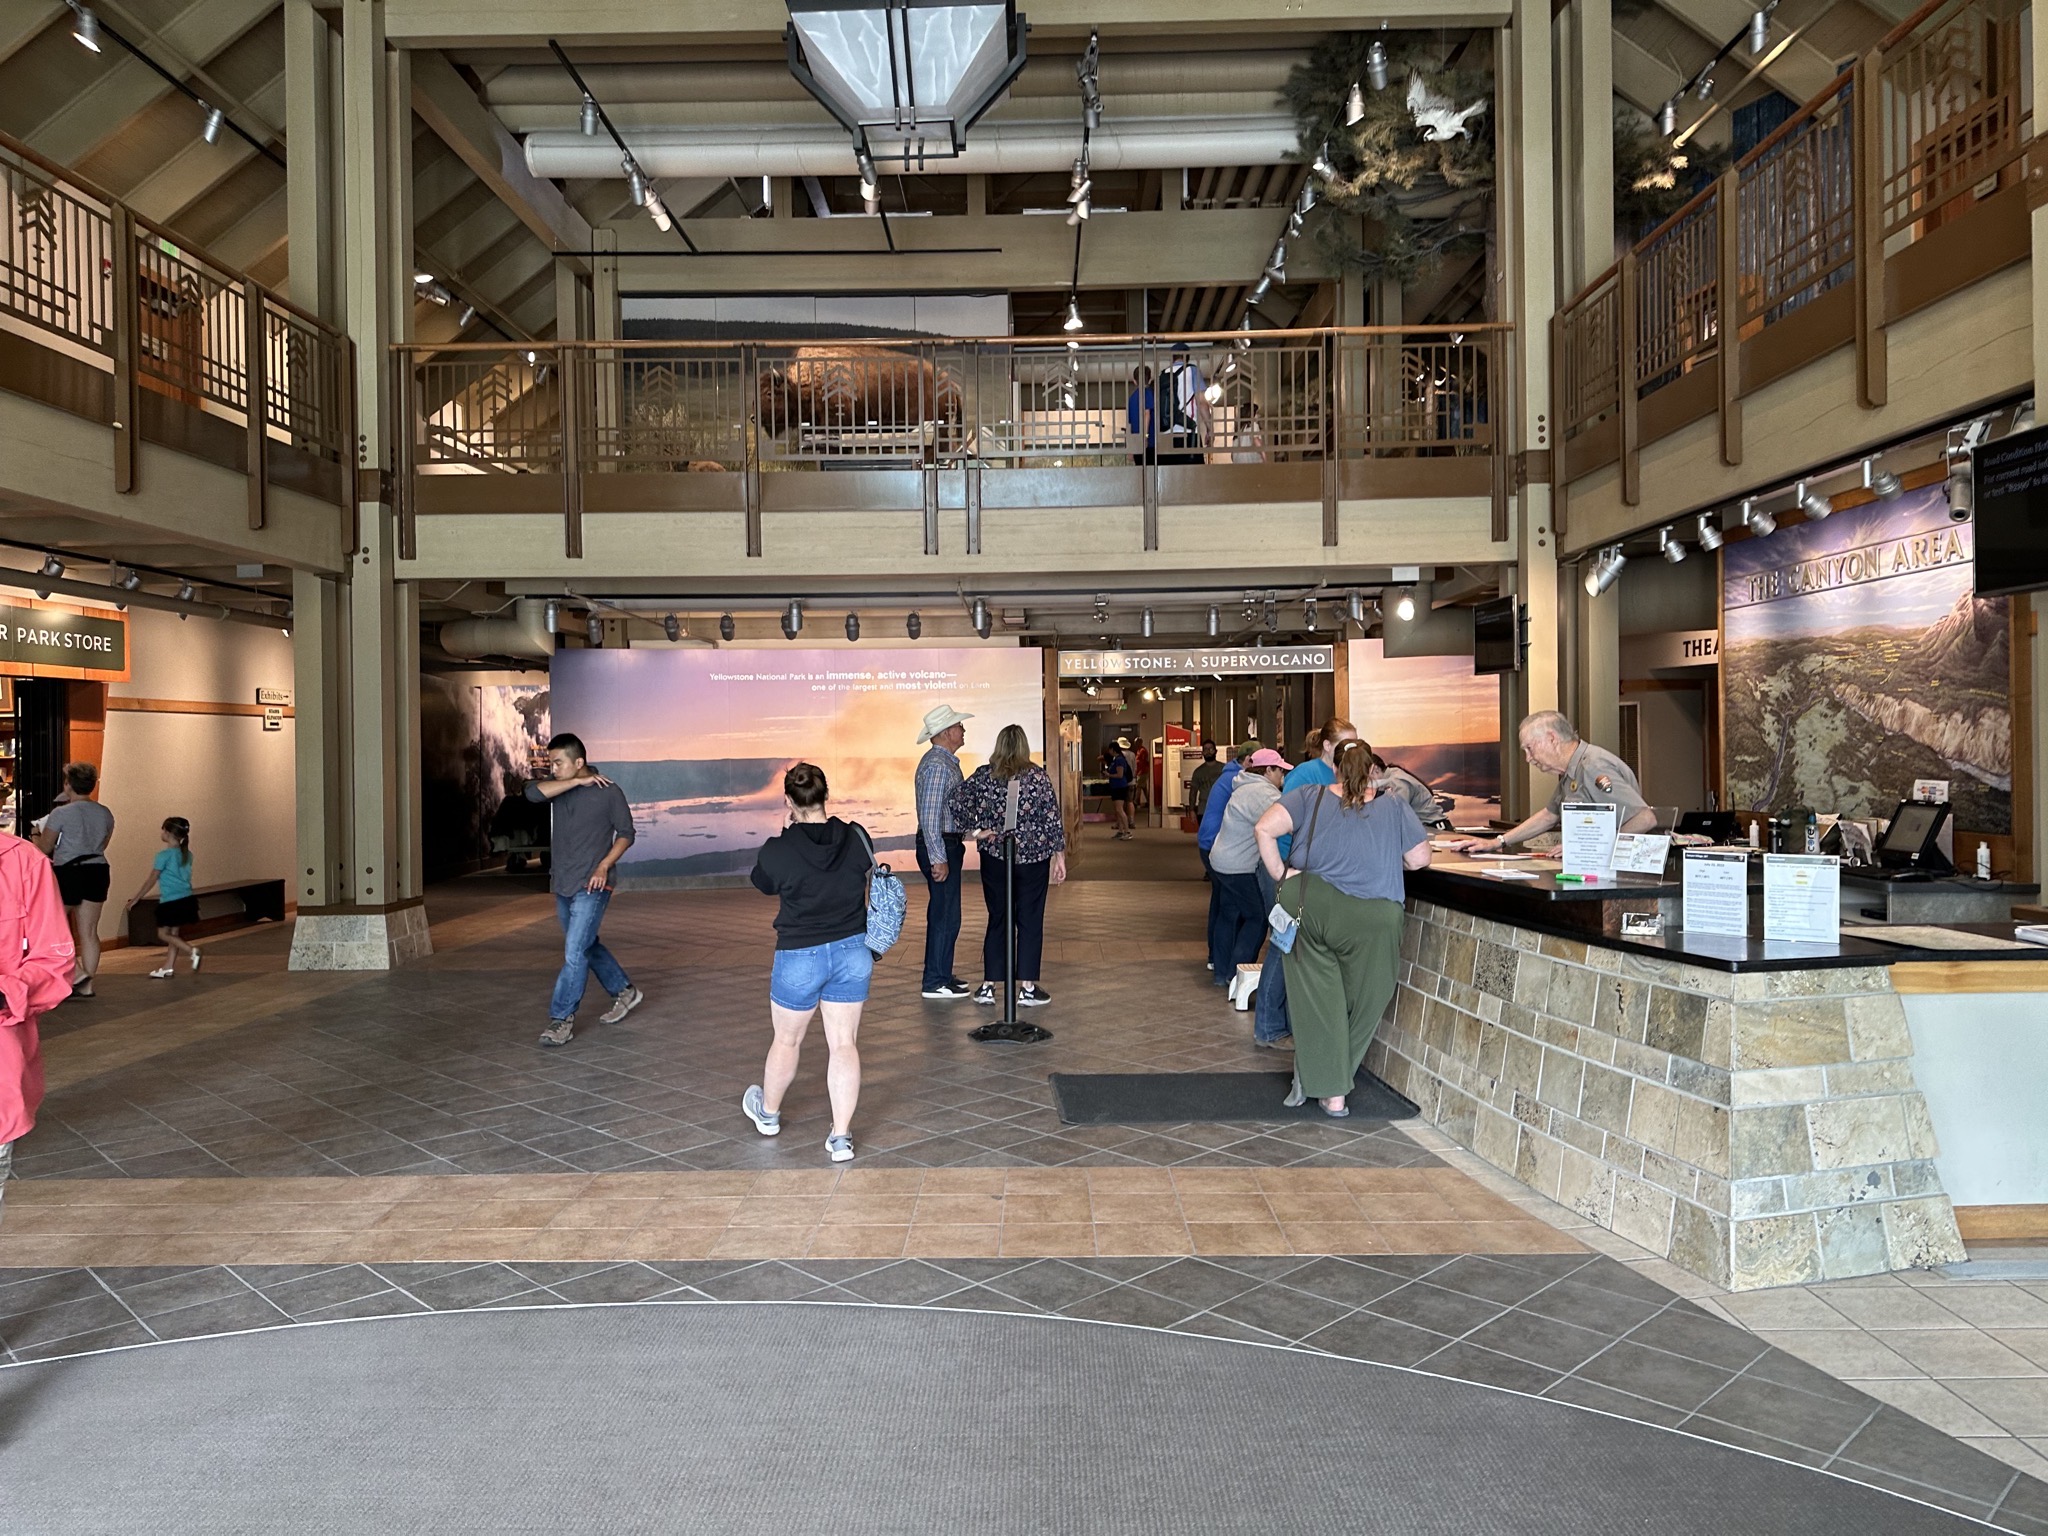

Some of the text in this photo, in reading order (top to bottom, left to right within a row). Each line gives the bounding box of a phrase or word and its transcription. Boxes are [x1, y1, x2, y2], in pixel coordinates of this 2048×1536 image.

[1746, 528, 1965, 602] THE CANYON AREA
[17, 627, 61, 647] PARK
[64, 632, 112, 652] STORE
[1064, 653, 1326, 670] YELLOWSTONE: A SUPERVOLCANO
[709, 673, 754, 681] Yellowstone
[756, 673, 787, 681] National
[789, 673, 806, 681] Park
[808, 672, 814, 680] is
[826, 671, 875, 681] immense,
[877, 670, 907, 680] active
[828, 683, 836, 691] of
[838, 683, 850, 691] the
[853, 683, 878, 692] largest
[896, 680, 921, 690] most
[924, 680, 957, 690] violent
[261, 690, 283, 700] Exhibits
